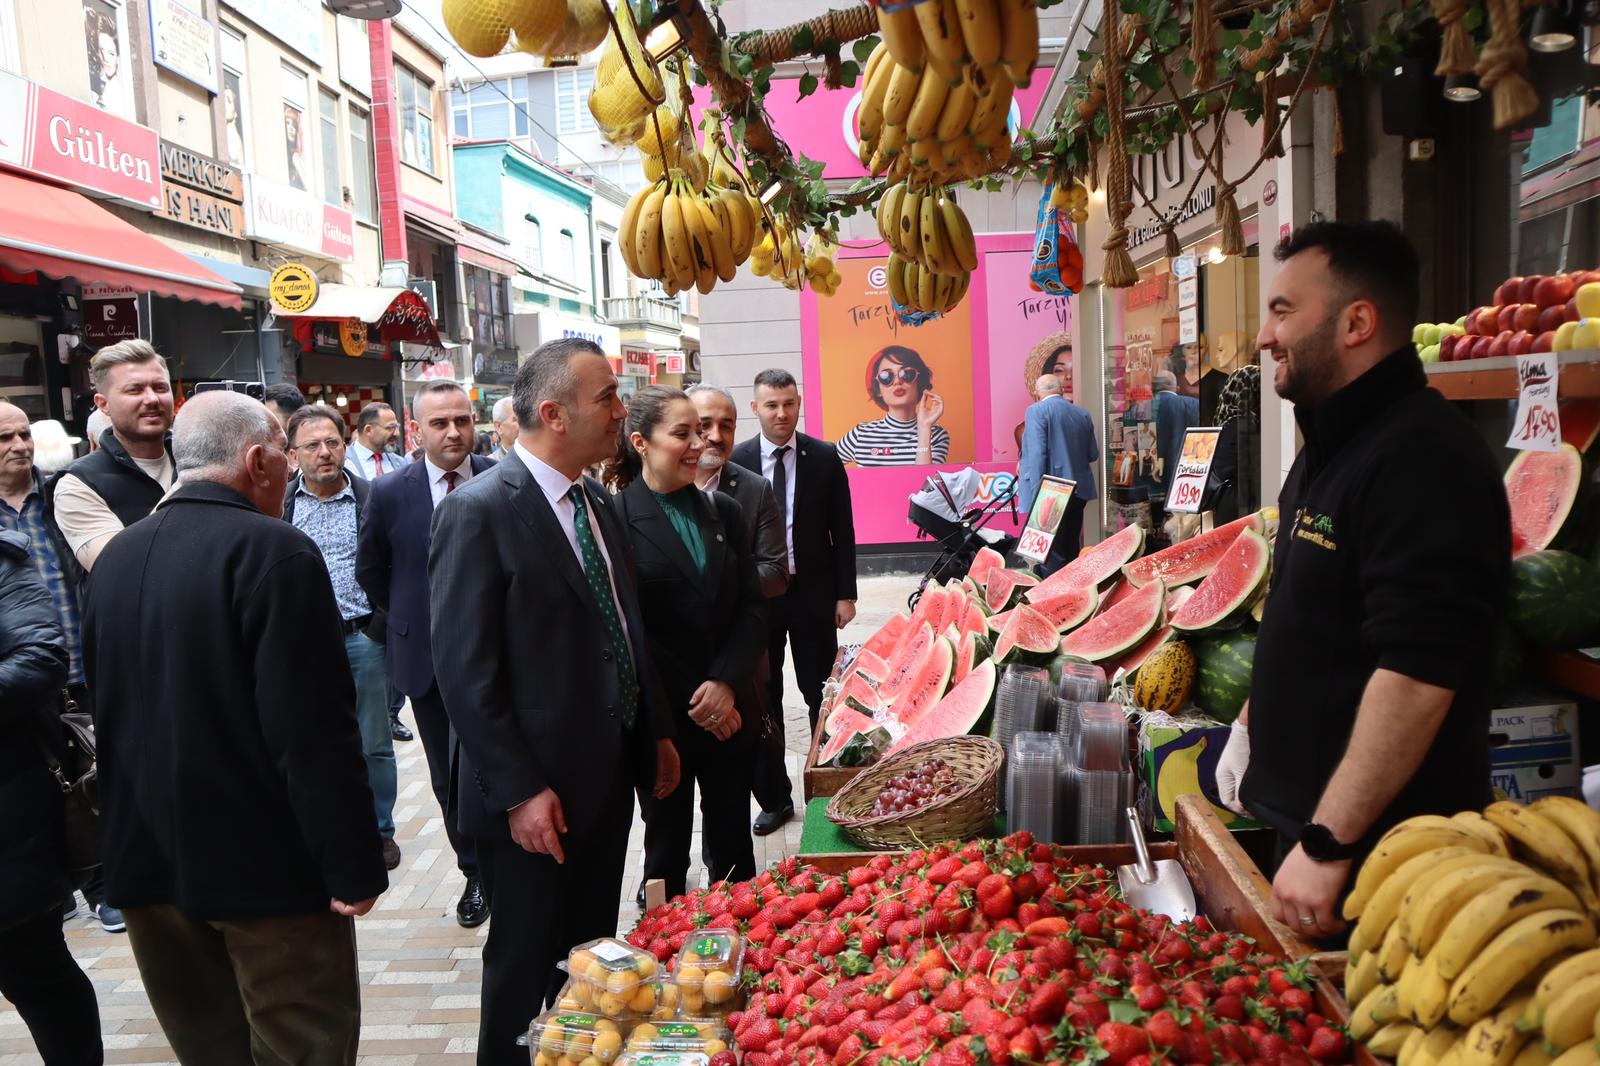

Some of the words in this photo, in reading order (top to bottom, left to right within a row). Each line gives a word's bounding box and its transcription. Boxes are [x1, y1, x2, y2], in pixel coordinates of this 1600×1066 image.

[49, 115, 153, 184] Gülten
[159, 144, 234, 194] MERKEZ
[324, 222, 352, 246] Gülten
[1496, 715, 1526, 727] PACK
